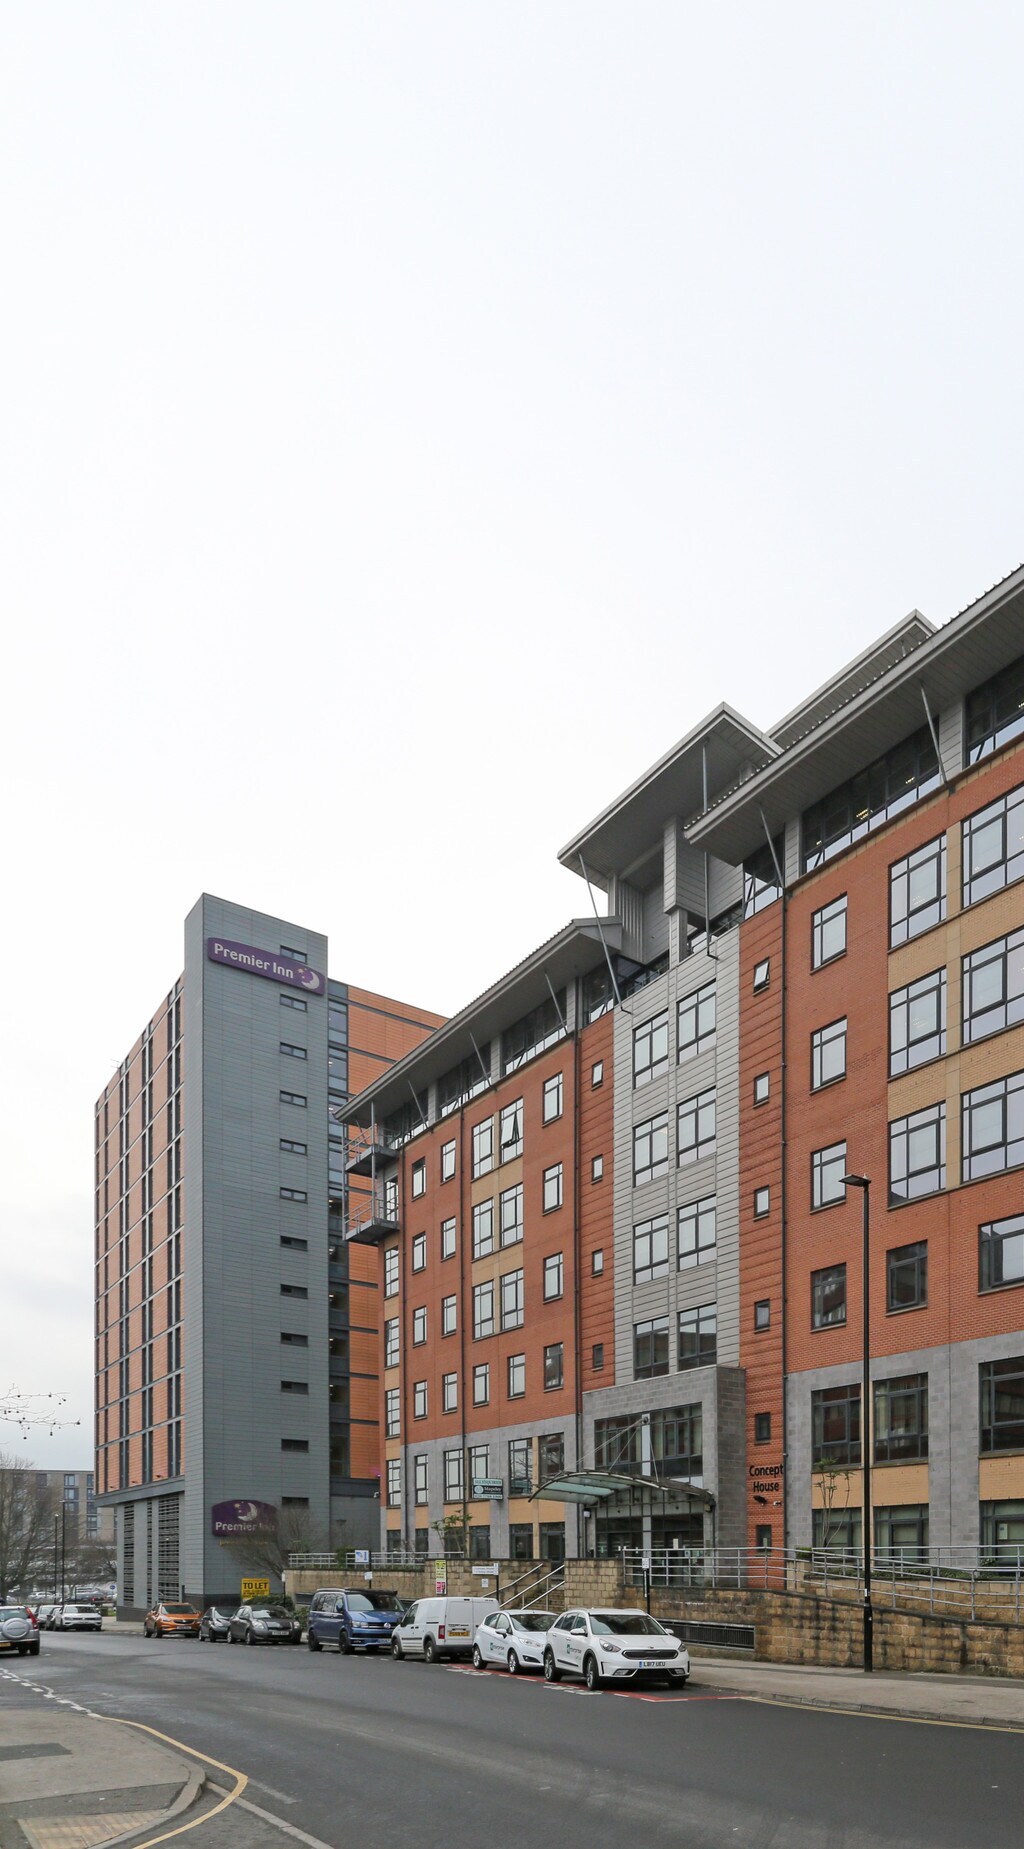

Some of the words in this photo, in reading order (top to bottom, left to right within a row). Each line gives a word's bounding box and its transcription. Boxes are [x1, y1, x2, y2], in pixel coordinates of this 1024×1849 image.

[214, 943, 270, 970] Premier
[273, 962, 294, 979] Inn
[749, 1464, 784, 1478] Concept
[753, 1481, 780, 1492] House
[215, 1521, 257, 1531] Premier
